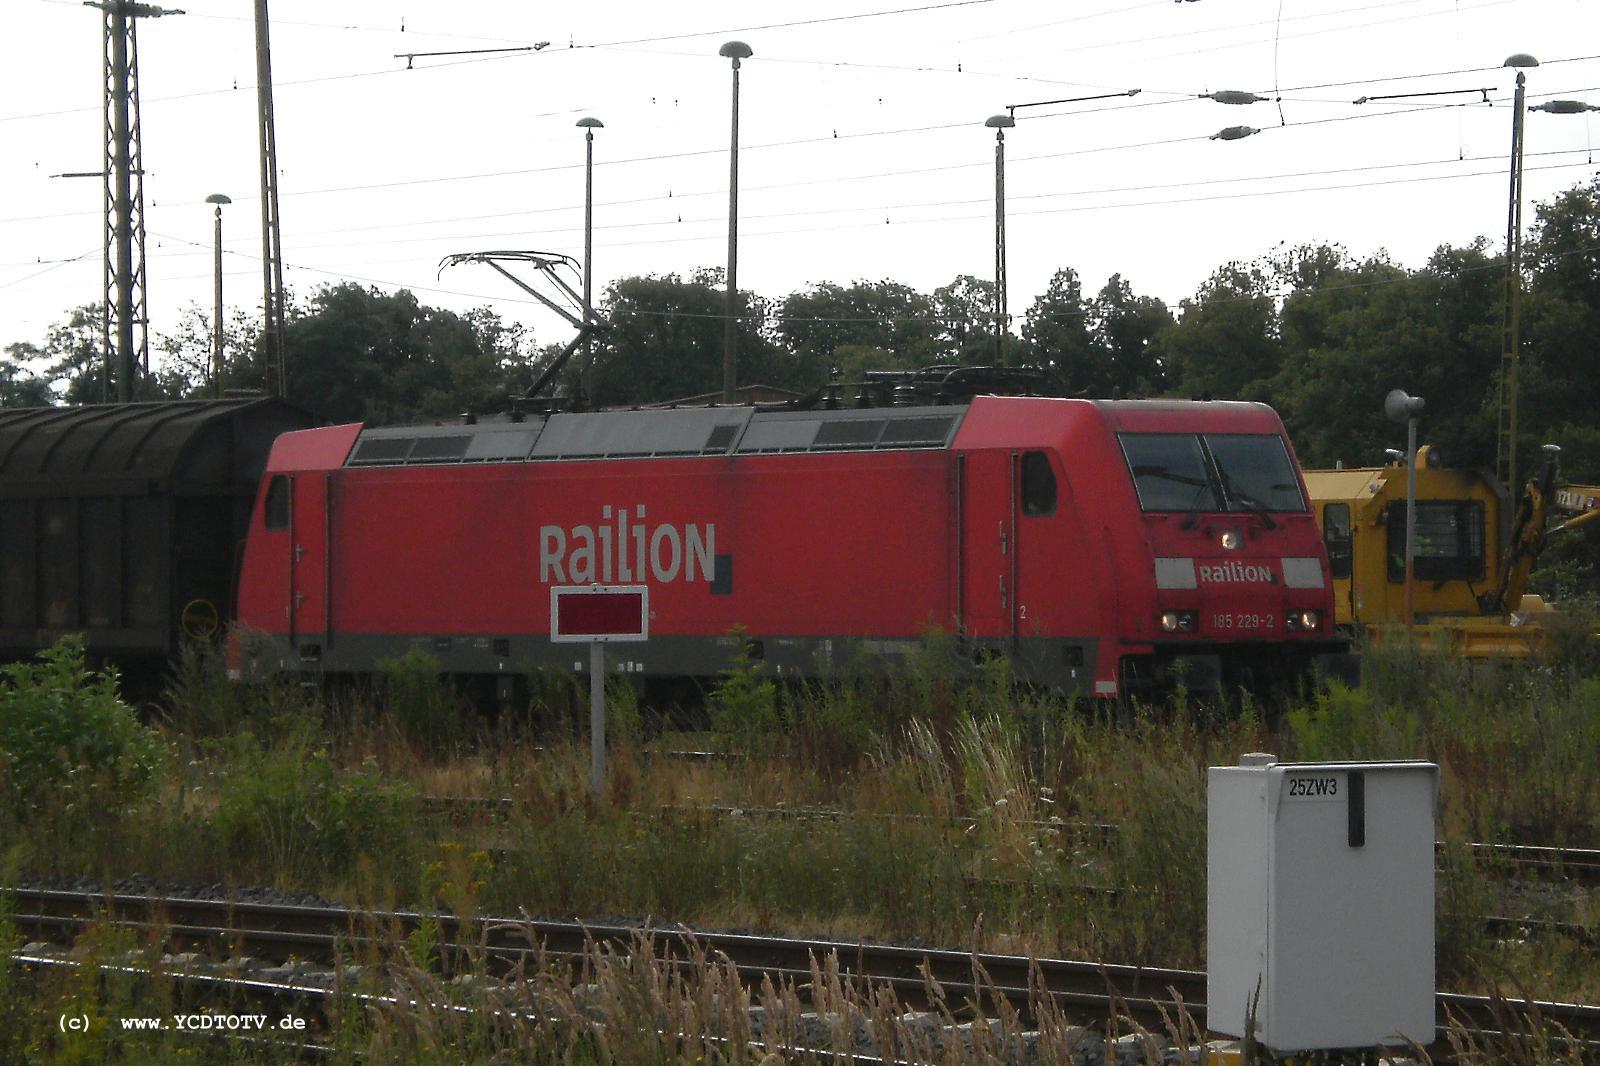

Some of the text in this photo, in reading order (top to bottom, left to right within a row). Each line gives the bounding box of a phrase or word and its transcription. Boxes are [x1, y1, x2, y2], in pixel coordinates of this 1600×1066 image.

[1020, 605, 1026, 619] 2
[1213, 614, 1274, 629] 185 229-2
[1289, 778, 1337, 796] 25ZW3
